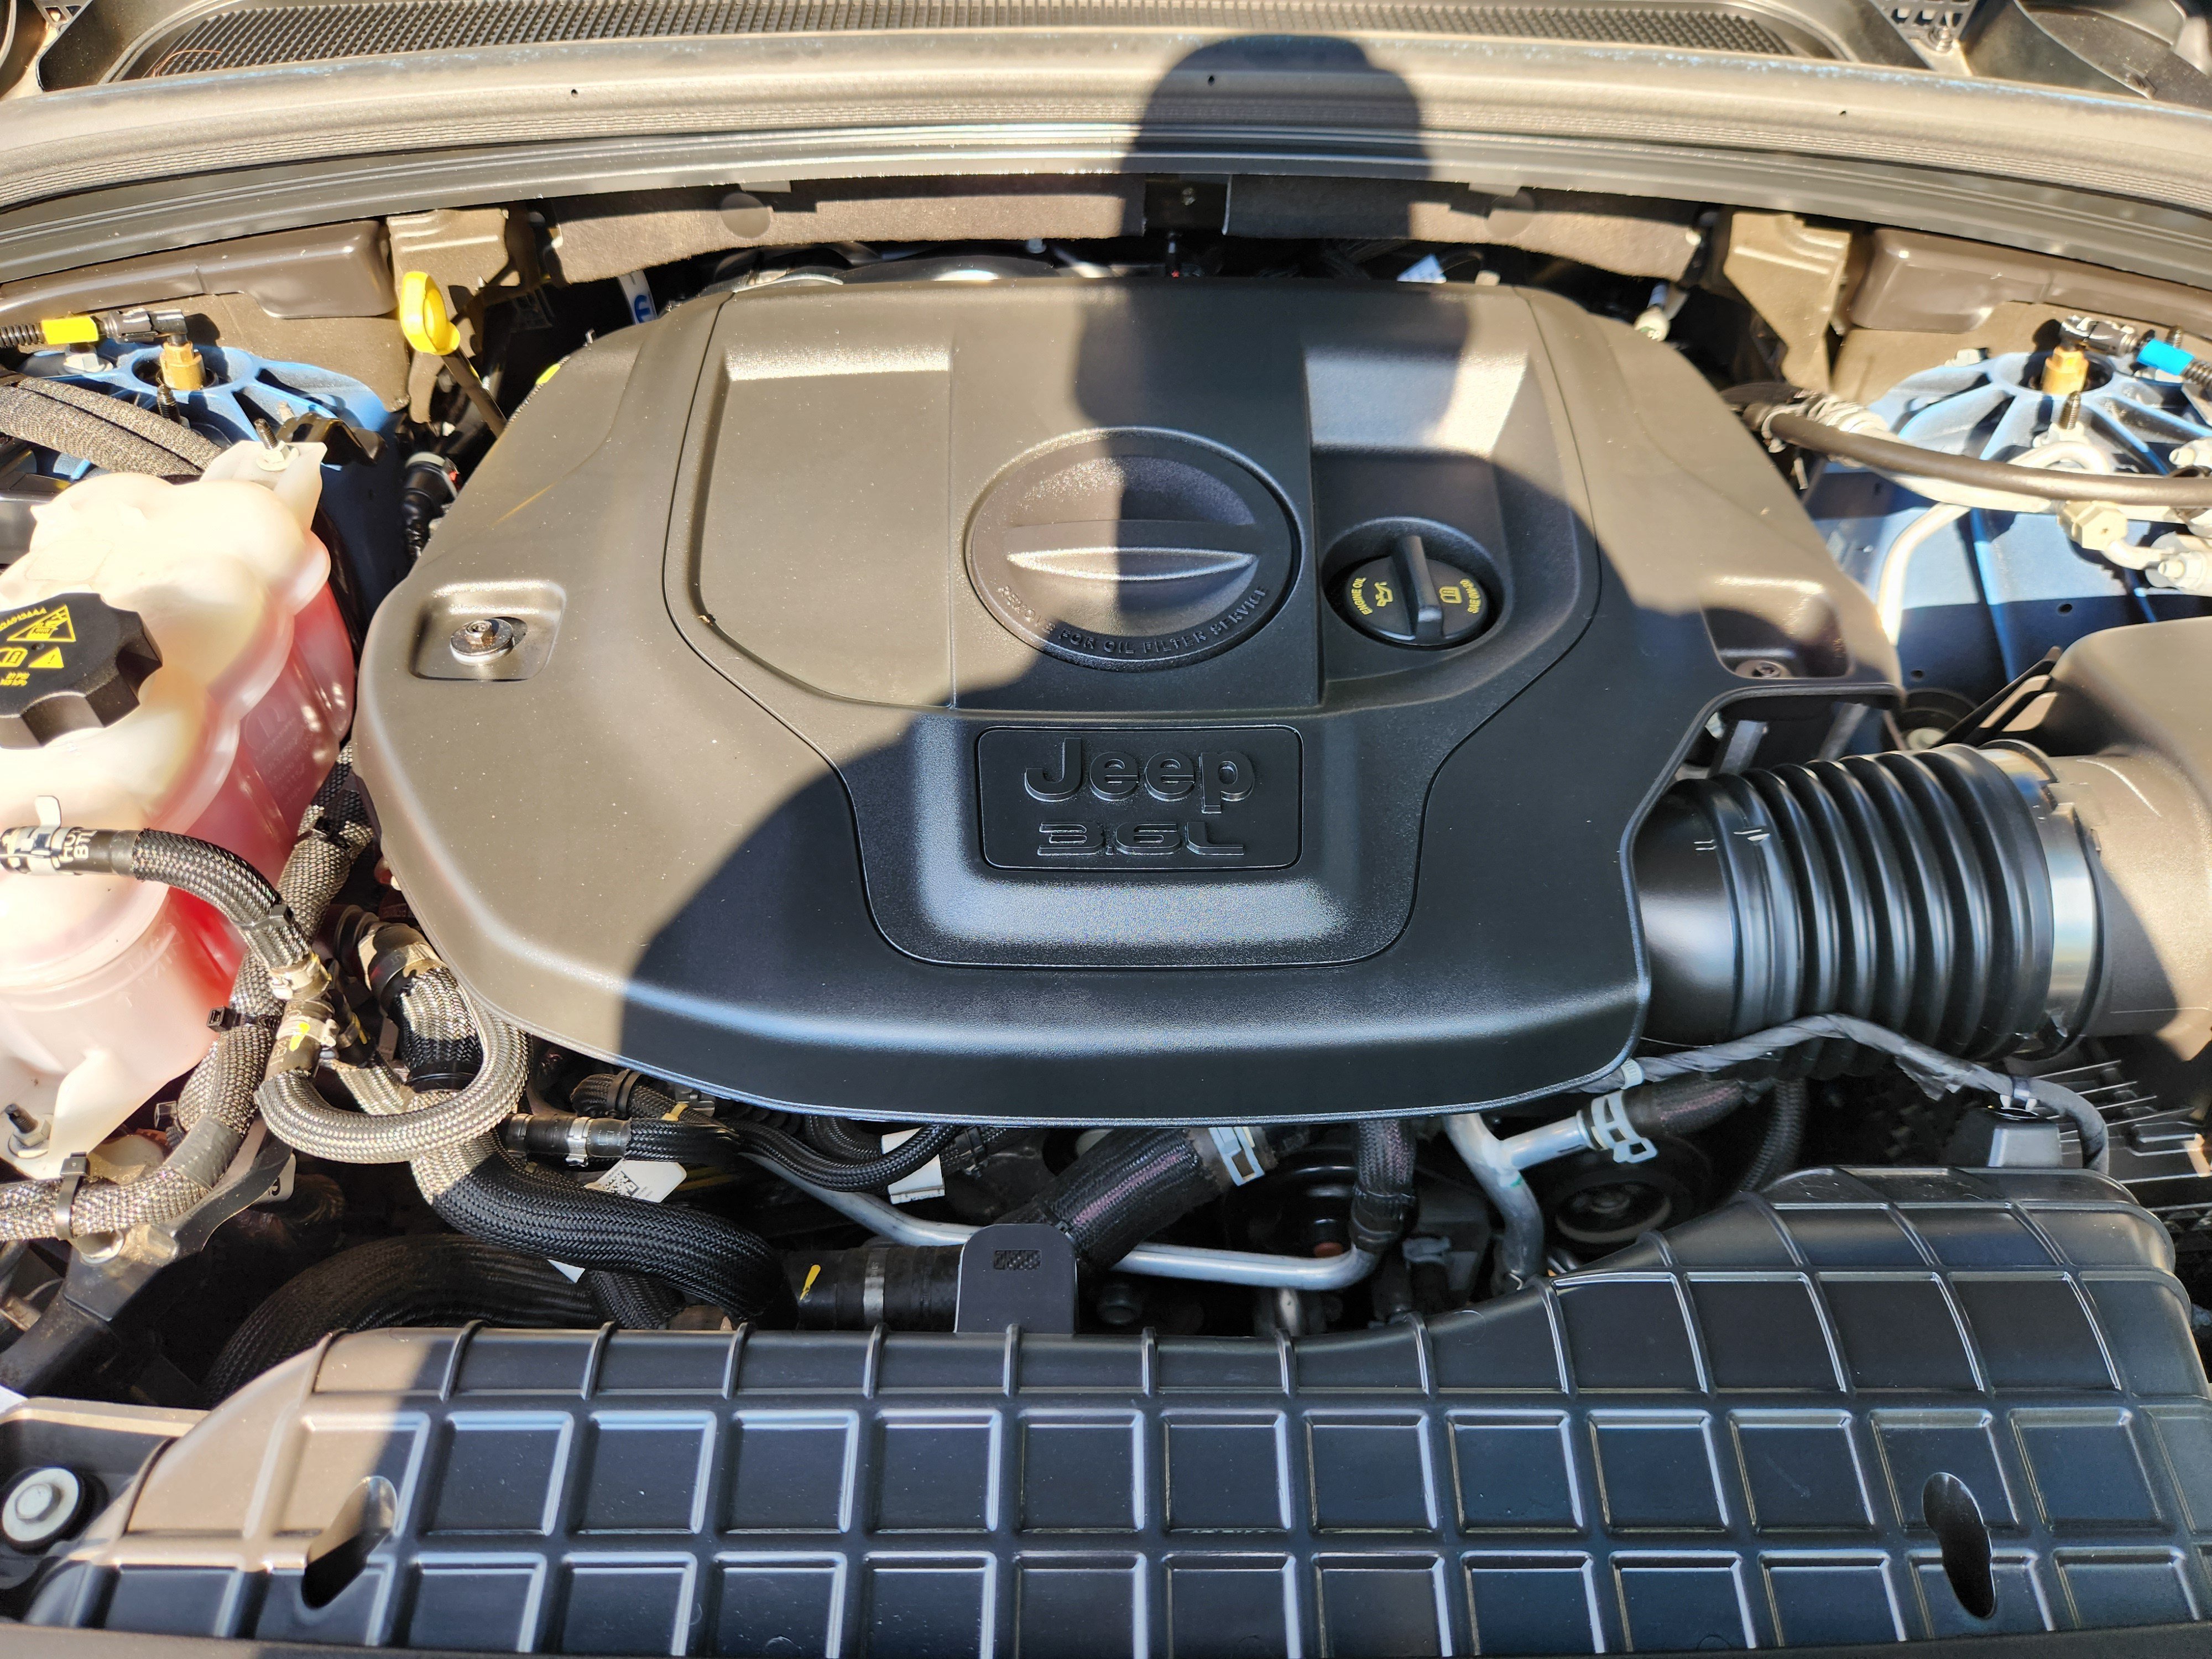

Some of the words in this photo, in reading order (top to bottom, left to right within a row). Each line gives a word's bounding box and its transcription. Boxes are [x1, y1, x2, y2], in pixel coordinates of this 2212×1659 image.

[1352, 577, 1367, 588] OIL
[1351, 588, 1373, 615] ENGINE
[1467, 598, 1481, 613] SAE
[997, 585, 1056, 634] REMOVE
[1058, 628, 1096, 650] FOR
[1103, 640, 1135, 654] OIL
[1142, 630, 1207, 654] FILTER
[1210, 586, 1270, 635] SERVICE
[1024, 737, 1255, 814] Jeep
[1037, 822, 1244, 856] 3.6L
